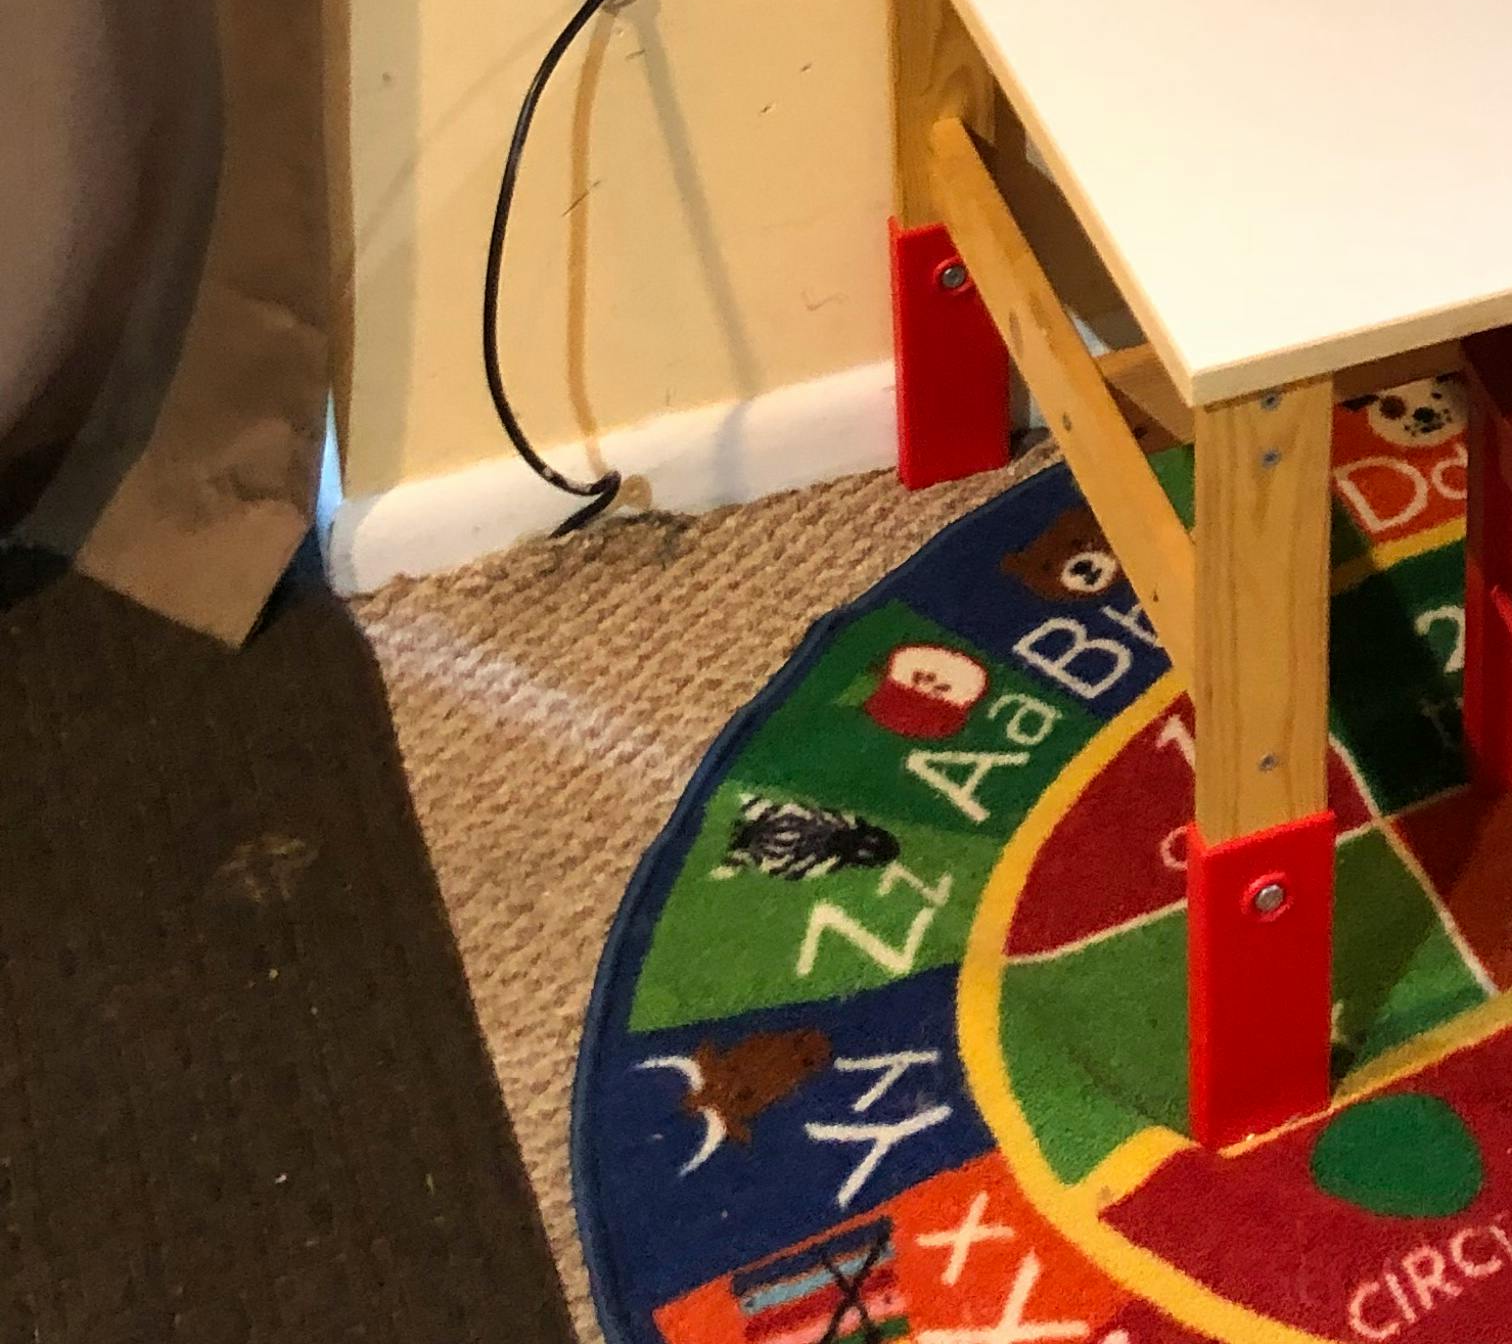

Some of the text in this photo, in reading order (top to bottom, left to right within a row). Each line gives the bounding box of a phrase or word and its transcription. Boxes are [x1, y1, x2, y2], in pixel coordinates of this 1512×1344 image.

[907, 692, 1062, 822] Aa
[796, 867, 953, 976] Zz
[804, 1051, 954, 1208] Yy
